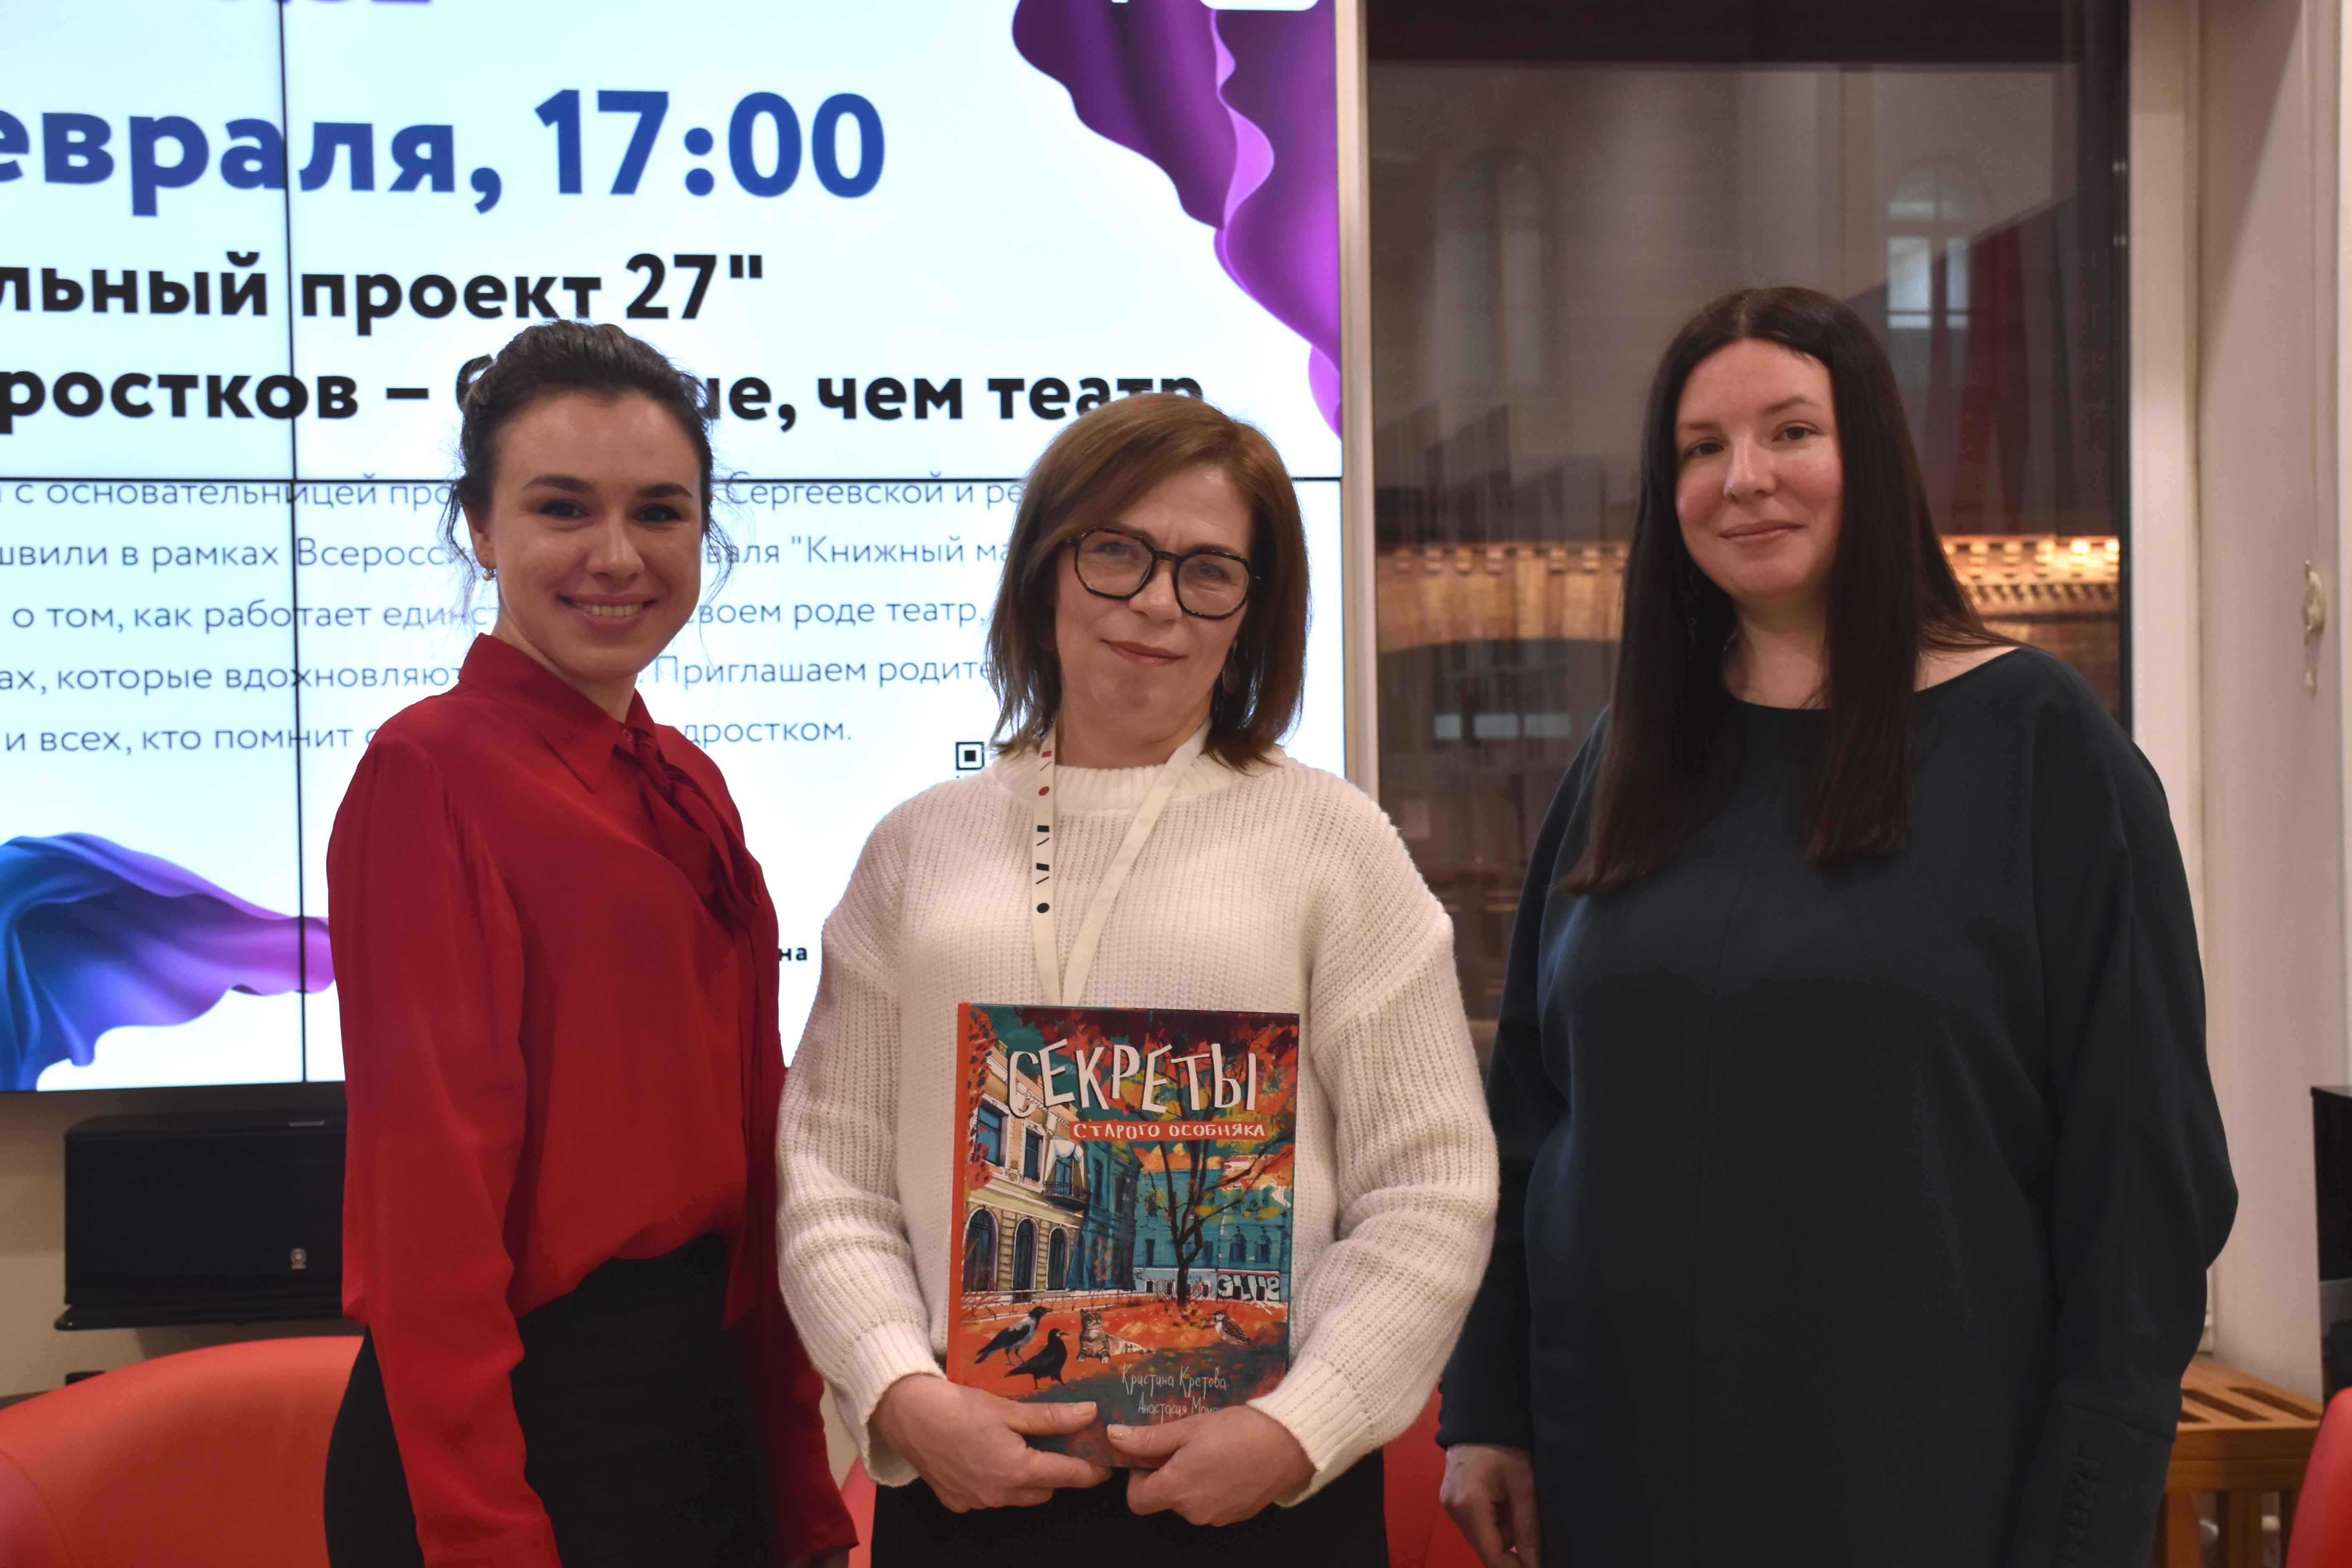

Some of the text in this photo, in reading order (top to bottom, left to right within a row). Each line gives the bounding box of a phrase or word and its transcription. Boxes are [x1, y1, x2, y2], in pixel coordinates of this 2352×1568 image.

[535, 90, 885, 198] 17:00
[302, 274, 602, 337] проект
[0, 371, 358, 435] ростков
[818, 377, 963, 420] чем
[15, 485, 34, 503] с
[47, 472, 375, 508] основательницей
[727, 471, 943, 511] Сергеевской
[956, 485, 974, 503] и
[122, 547, 138, 565] в
[153, 546, 278, 573] рамках
[297, 538, 454, 573] Всеросс
[792, 535, 963, 563] "Книжный
[13, 608, 34, 628] о
[47, 608, 123, 632] том,
[135, 608, 191, 627] как
[206, 599, 371, 634] работает
[687, 604, 780, 623] воем
[795, 604, 875, 629] роде
[58, 669, 212, 696] которые
[654, 655, 866, 689] Приглашаем
[6, 733, 25, 751] и
[41, 732, 131, 755] всех,
[143, 731, 201, 750] кто
[215, 729, 353, 749] помнит
[1008, 1038, 1256, 1118] СЕКРЕТЫ
[1169, 1123, 1265, 1138] ОСОБНЯКА
[1122, 1363, 1175, 1397] Кристина
[1137, 1391, 1187, 1425] Анастасия
